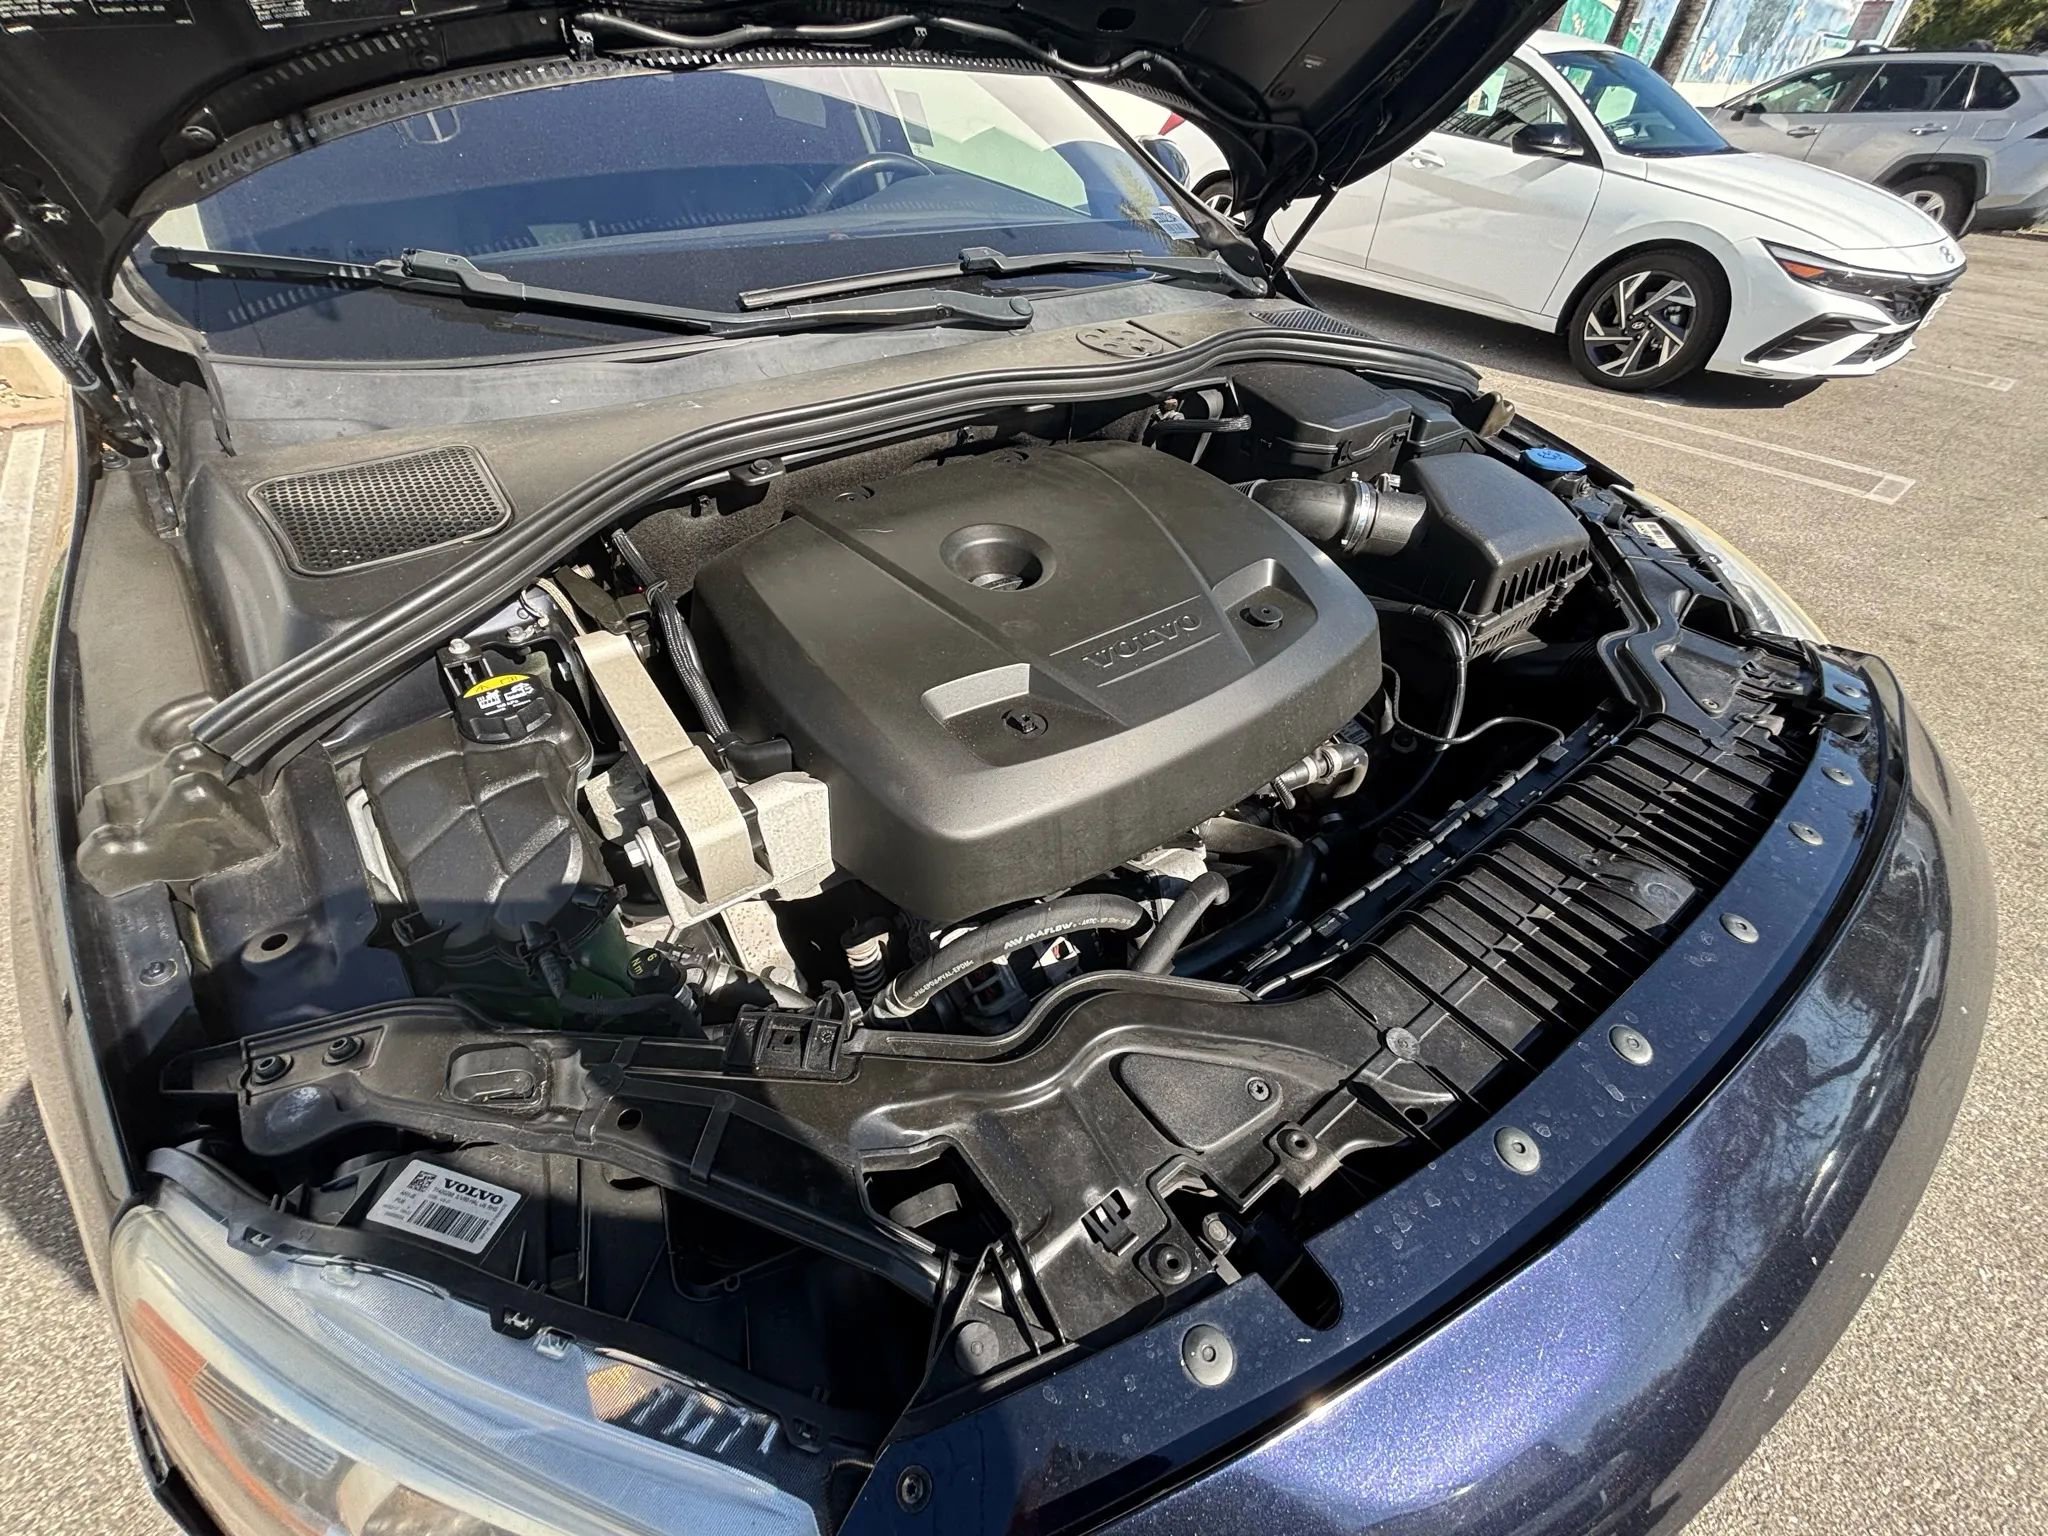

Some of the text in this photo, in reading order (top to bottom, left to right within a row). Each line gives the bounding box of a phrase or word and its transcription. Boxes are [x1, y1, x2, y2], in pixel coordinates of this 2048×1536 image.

[1081, 614, 1202, 668] VOLVO
[632, 958, 643, 975] Nm
[648, 953, 657, 962] 6
[444, 1178, 504, 1205] VOLVO
